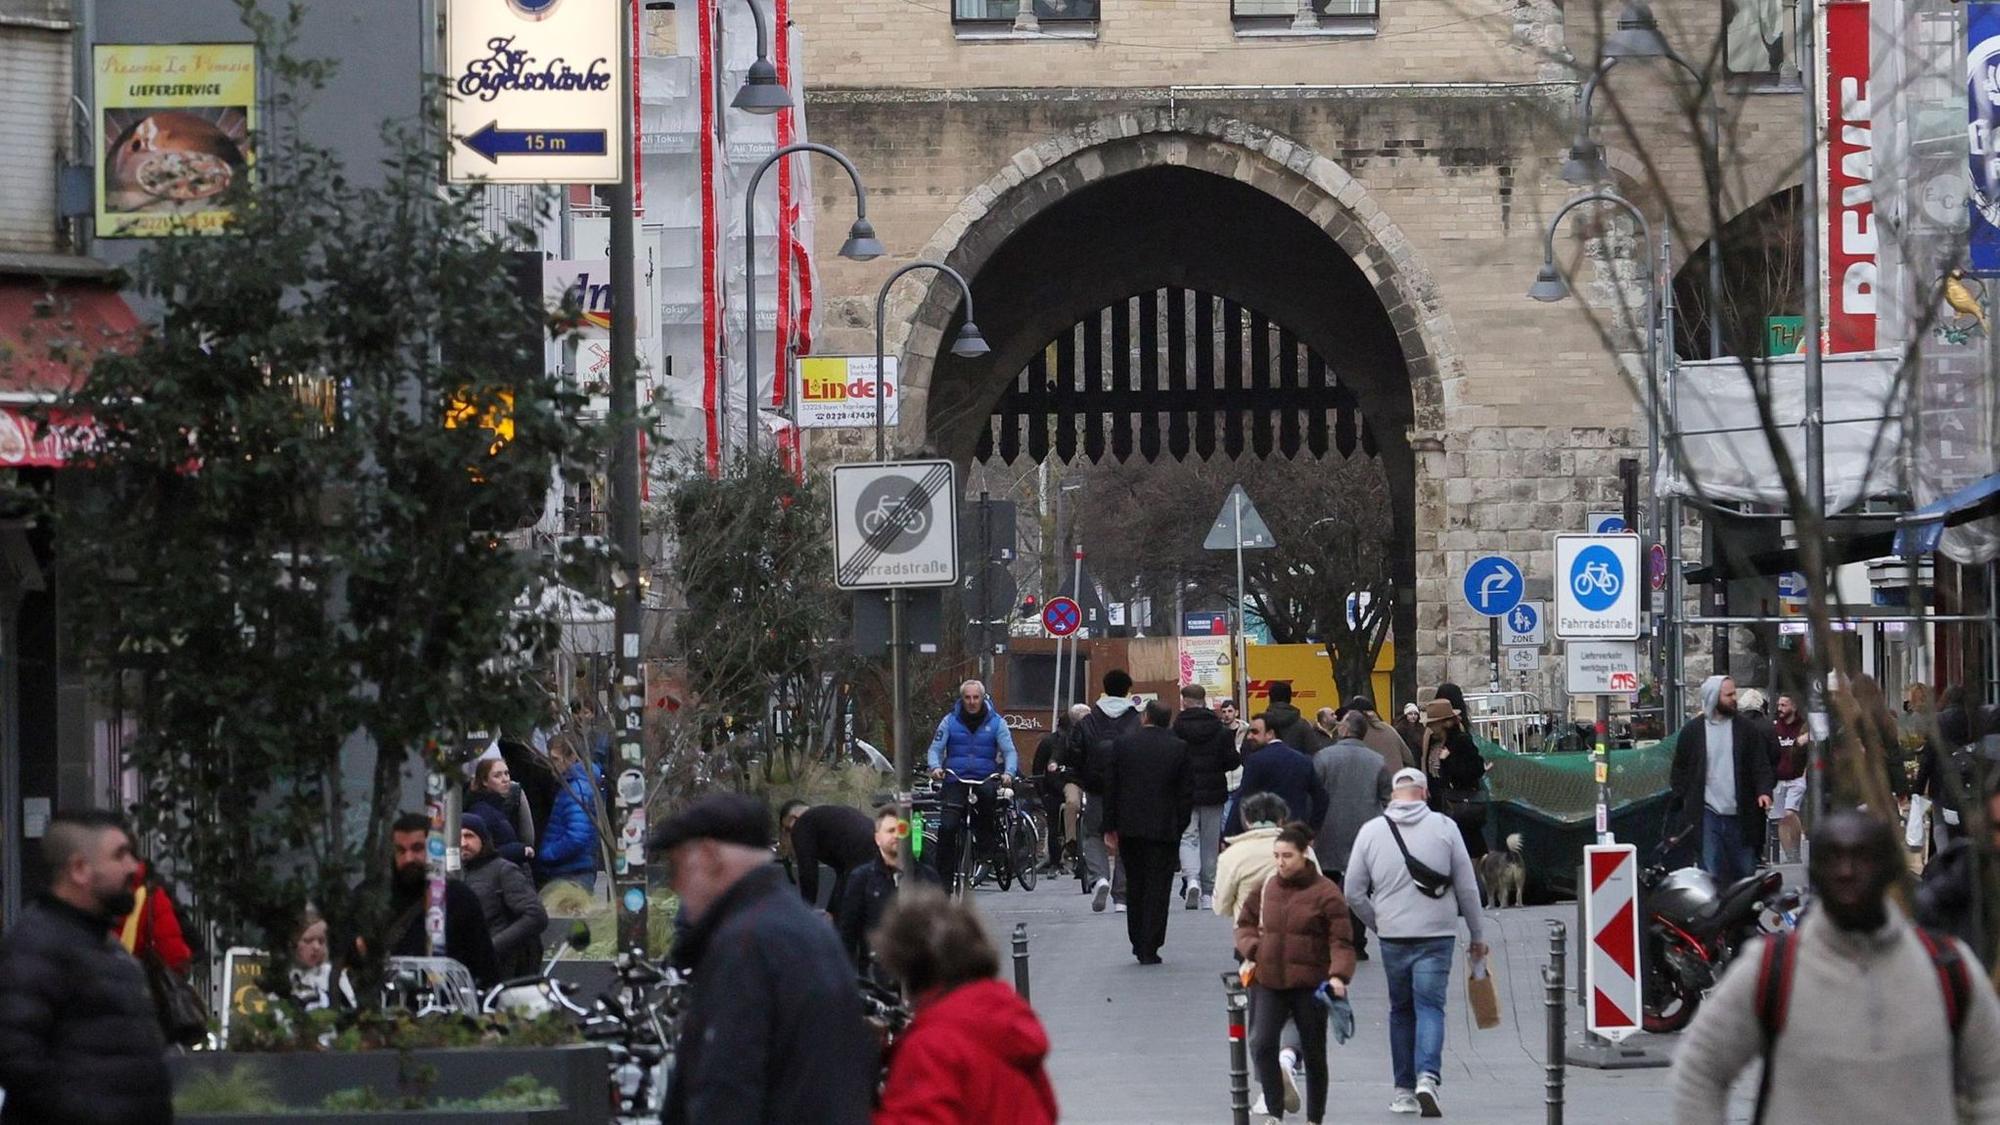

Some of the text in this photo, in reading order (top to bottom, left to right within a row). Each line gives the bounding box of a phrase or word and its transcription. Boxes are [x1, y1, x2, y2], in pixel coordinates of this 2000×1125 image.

[456, 57, 612, 103] Eigelschänke
[128, 83, 222, 97] LIEFERSERVICE
[525, 135, 566, 150] 15 m
[803, 377, 894, 400] Linden
[1560, 617, 1634, 630] Fahrradstraße
[1511, 634, 1535, 643] ZONE
